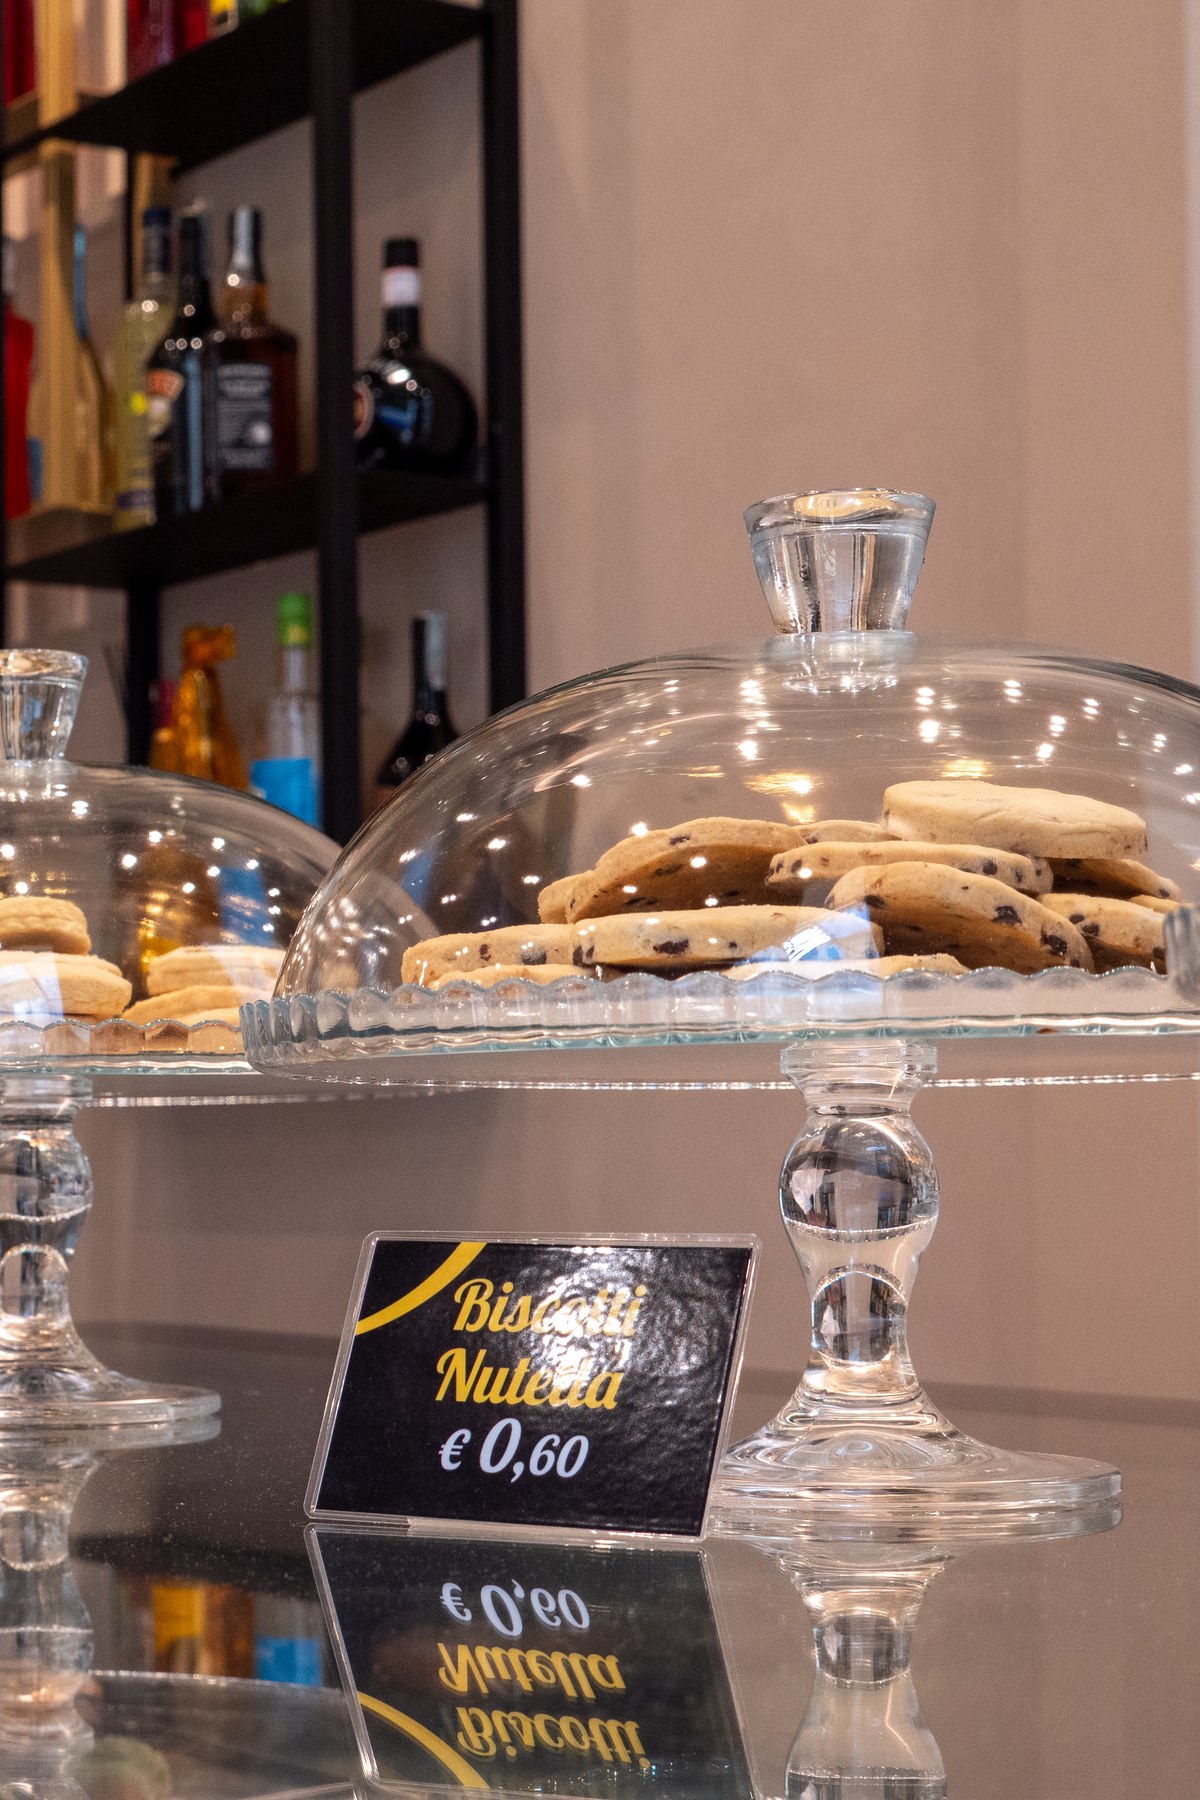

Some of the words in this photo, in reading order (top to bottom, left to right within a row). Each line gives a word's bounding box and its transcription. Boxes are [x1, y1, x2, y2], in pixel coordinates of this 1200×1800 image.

[454, 1278, 647, 1337] Biscotti
[439, 1429, 471, 1470] €
[480, 1418, 589, 1482] 0,60
